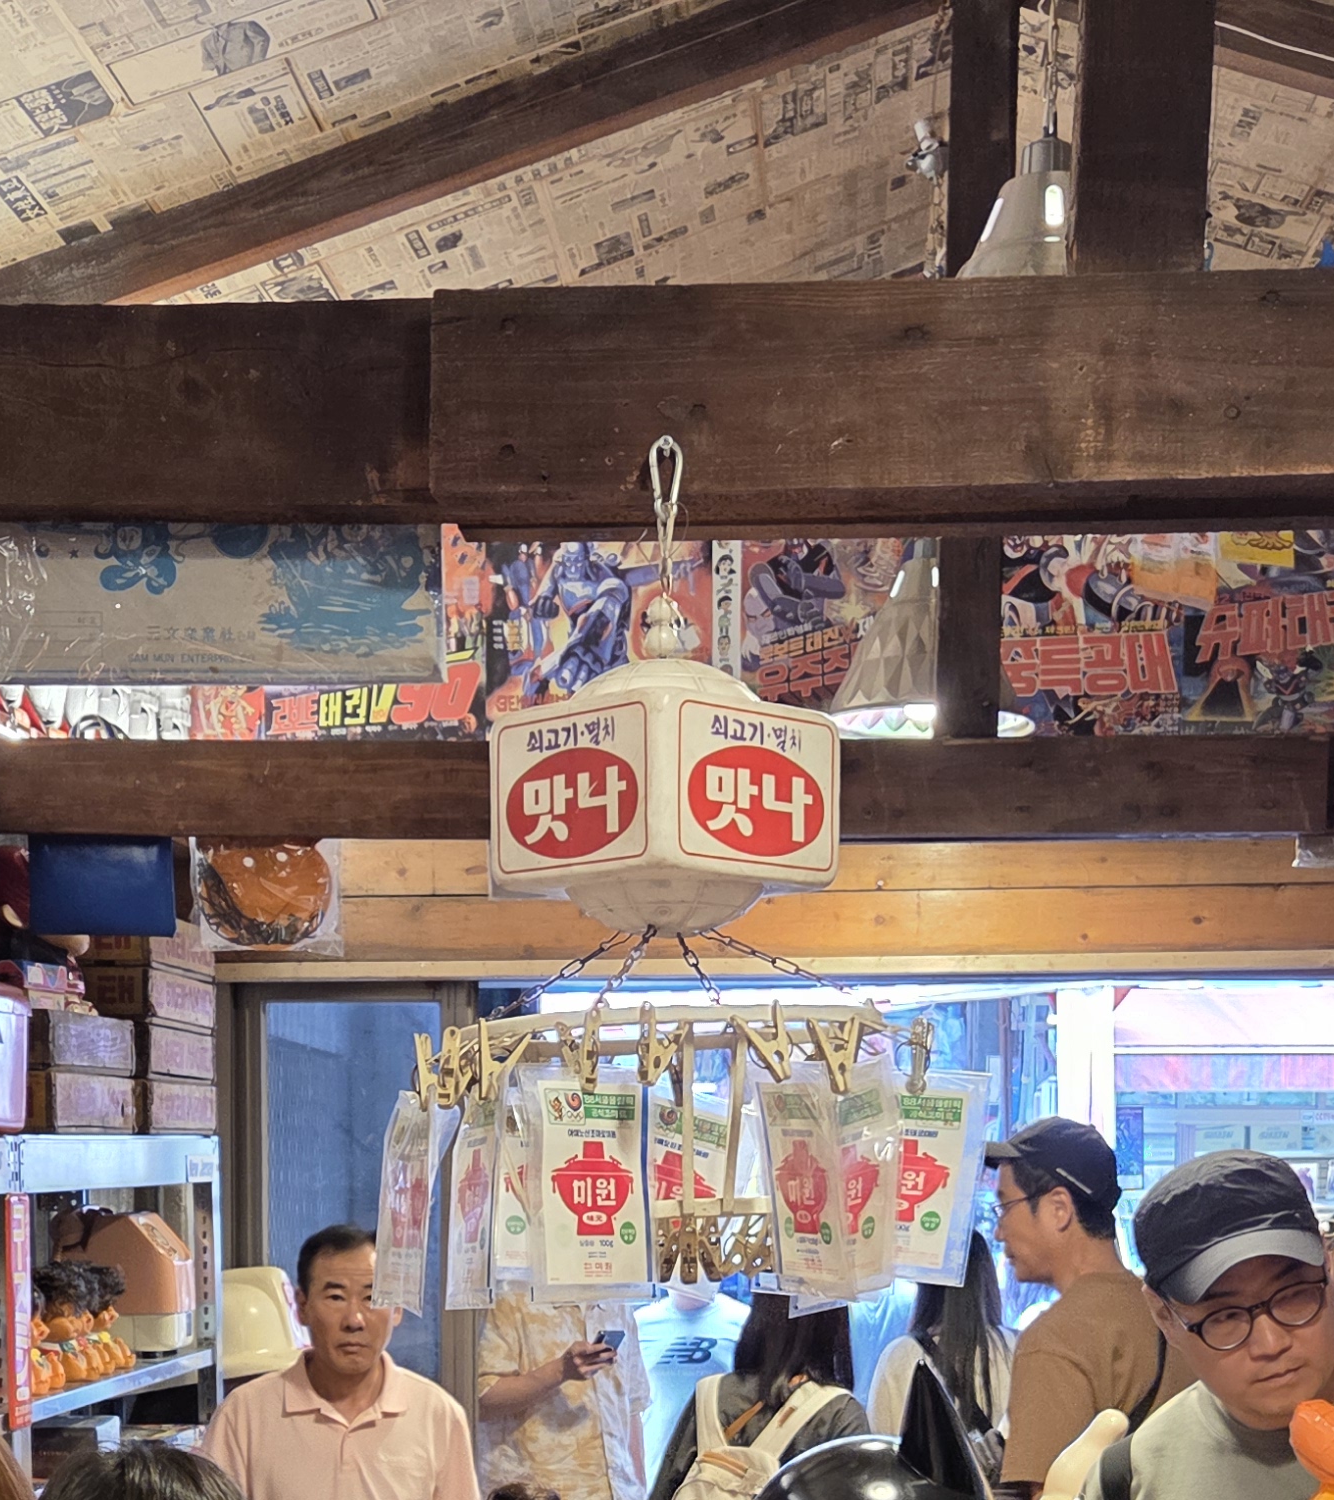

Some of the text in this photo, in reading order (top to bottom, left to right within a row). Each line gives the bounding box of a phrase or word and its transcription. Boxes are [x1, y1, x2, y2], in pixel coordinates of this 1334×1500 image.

[523, 764, 627, 845] 맛나
[705, 764, 814, 843] 맛나
[572, 1176, 617, 1208] 미원
